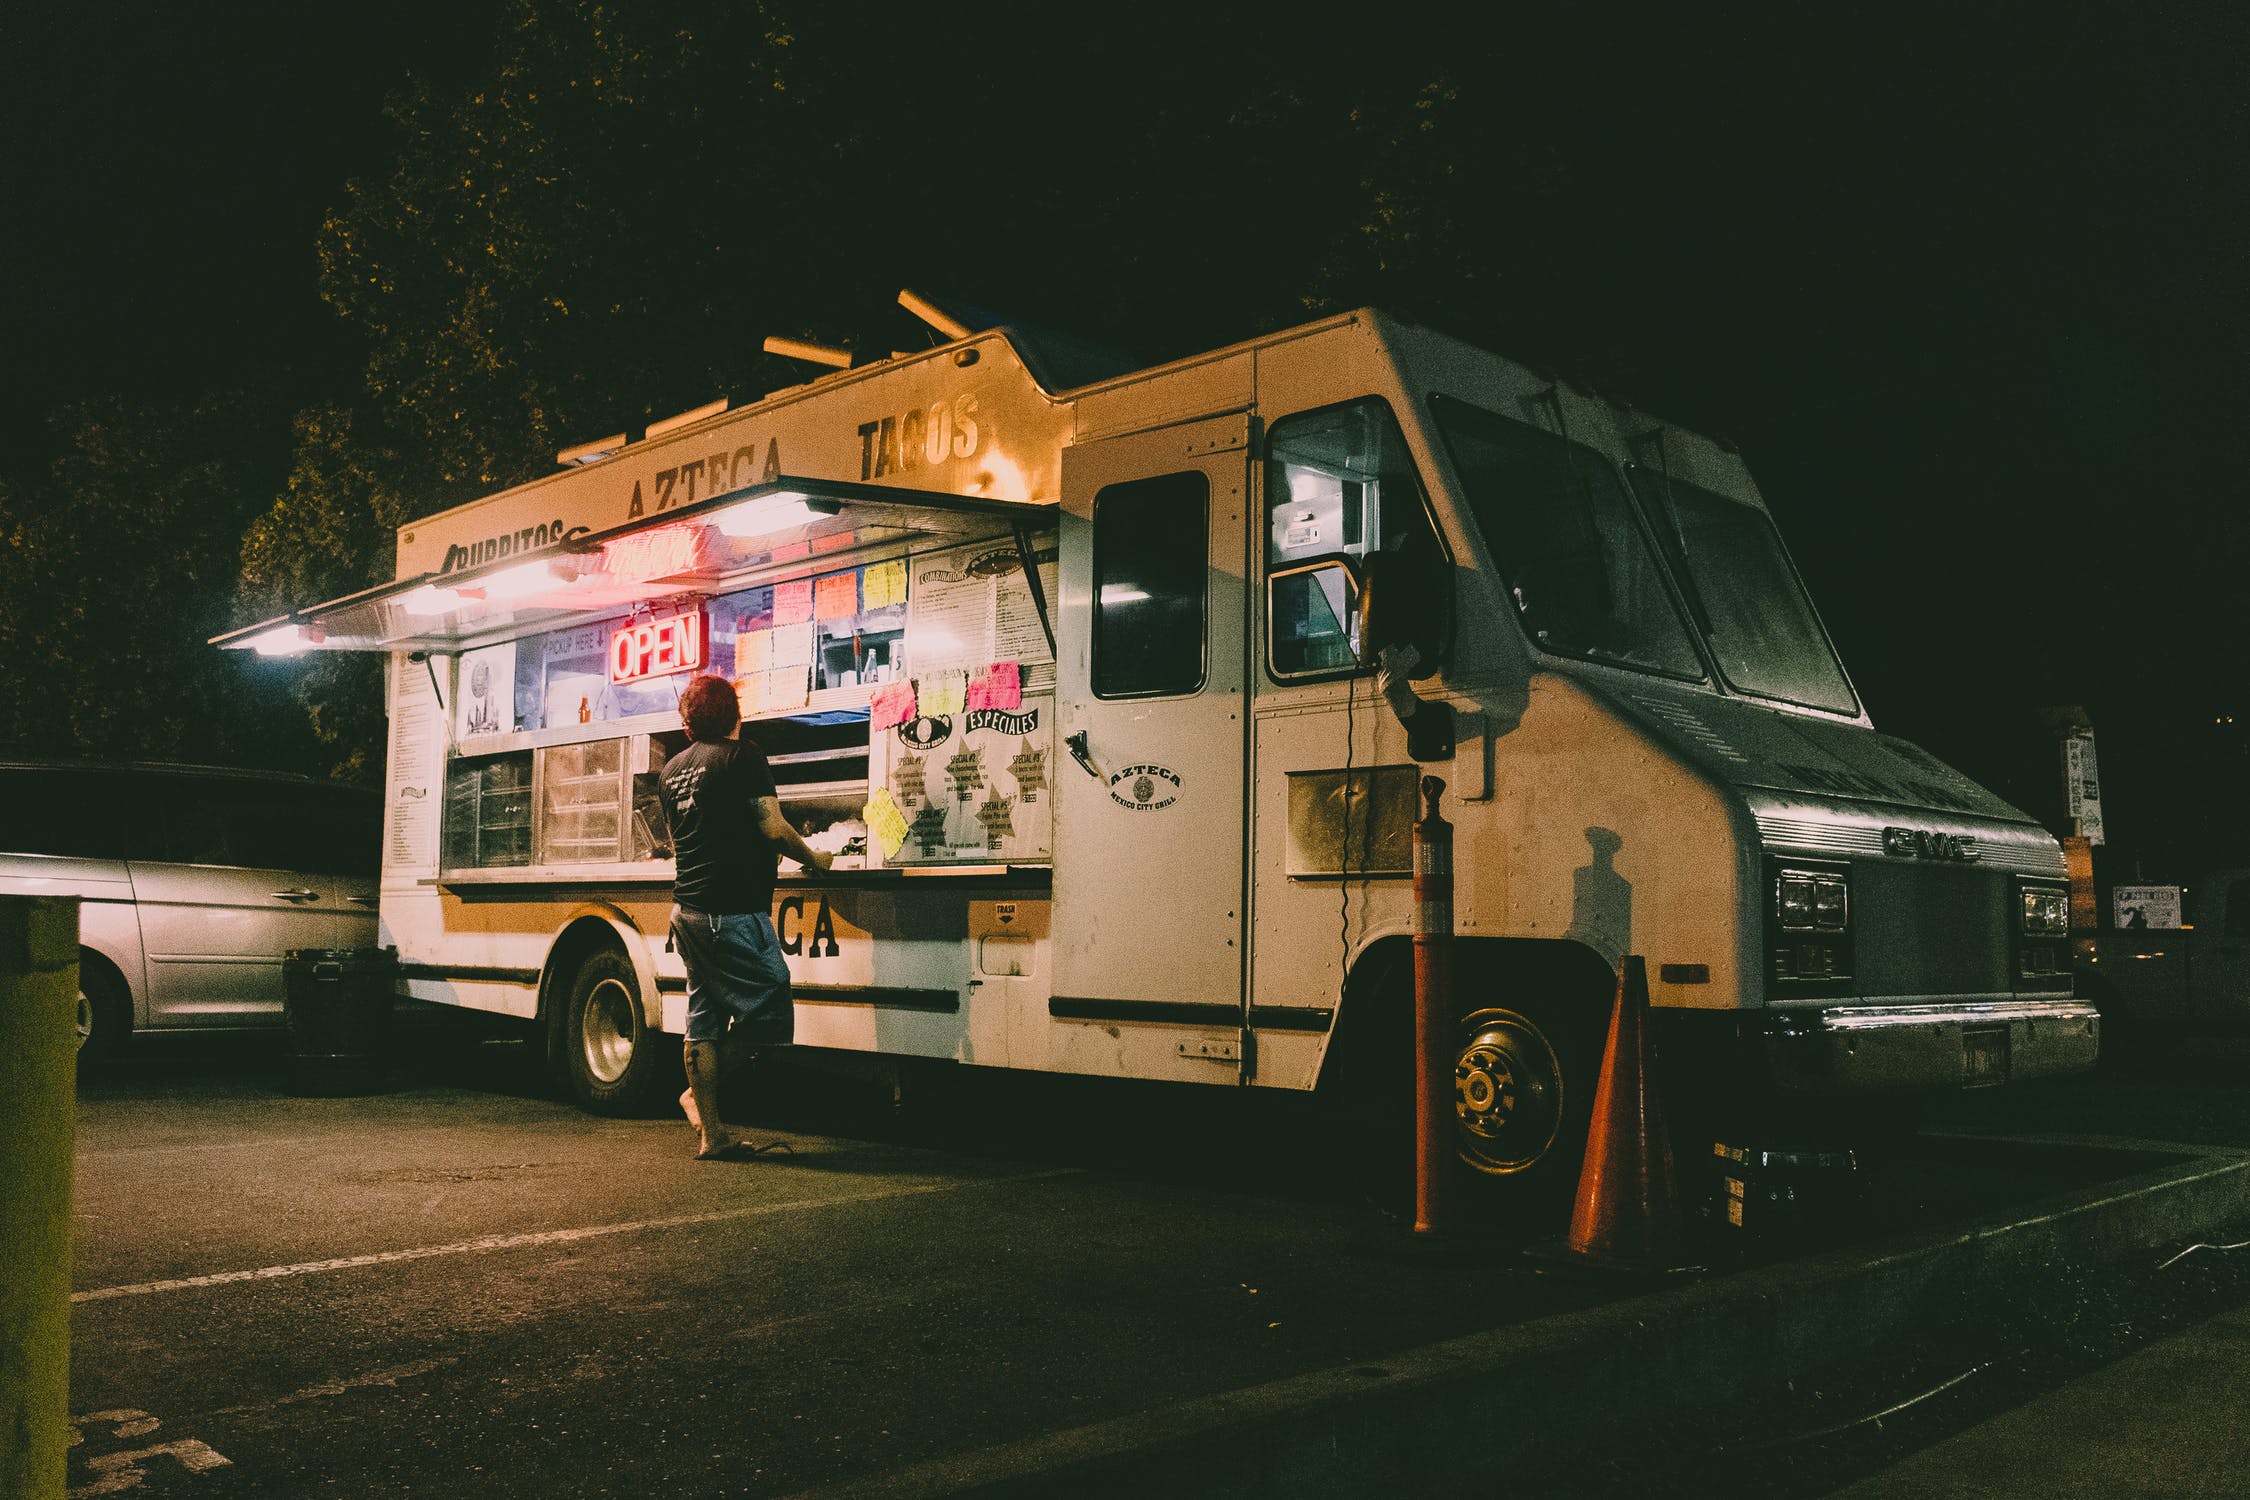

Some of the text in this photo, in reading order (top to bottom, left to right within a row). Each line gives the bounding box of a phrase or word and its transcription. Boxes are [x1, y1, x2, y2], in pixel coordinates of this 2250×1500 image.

[858, 394, 979, 482] TACOS
[628, 437, 783, 520] AZTECA
[575, 631, 595, 651] HERE
[612, 615, 697, 679] OPEN
[970, 711, 1035, 735] ESPECIALES
[950, 754, 968, 764] SPECIAL
[1012, 754, 1031, 764] SPECIAL
[1110, 765, 1181, 788] AZTECA
[981, 800, 1007, 811] SPECIAL #5
[1110, 791, 1135, 810] MEXICO
[1155, 796, 1176, 810] GRILL
[1882, 826, 1981, 863] GMC
[997, 904, 1016, 913] TRASH
